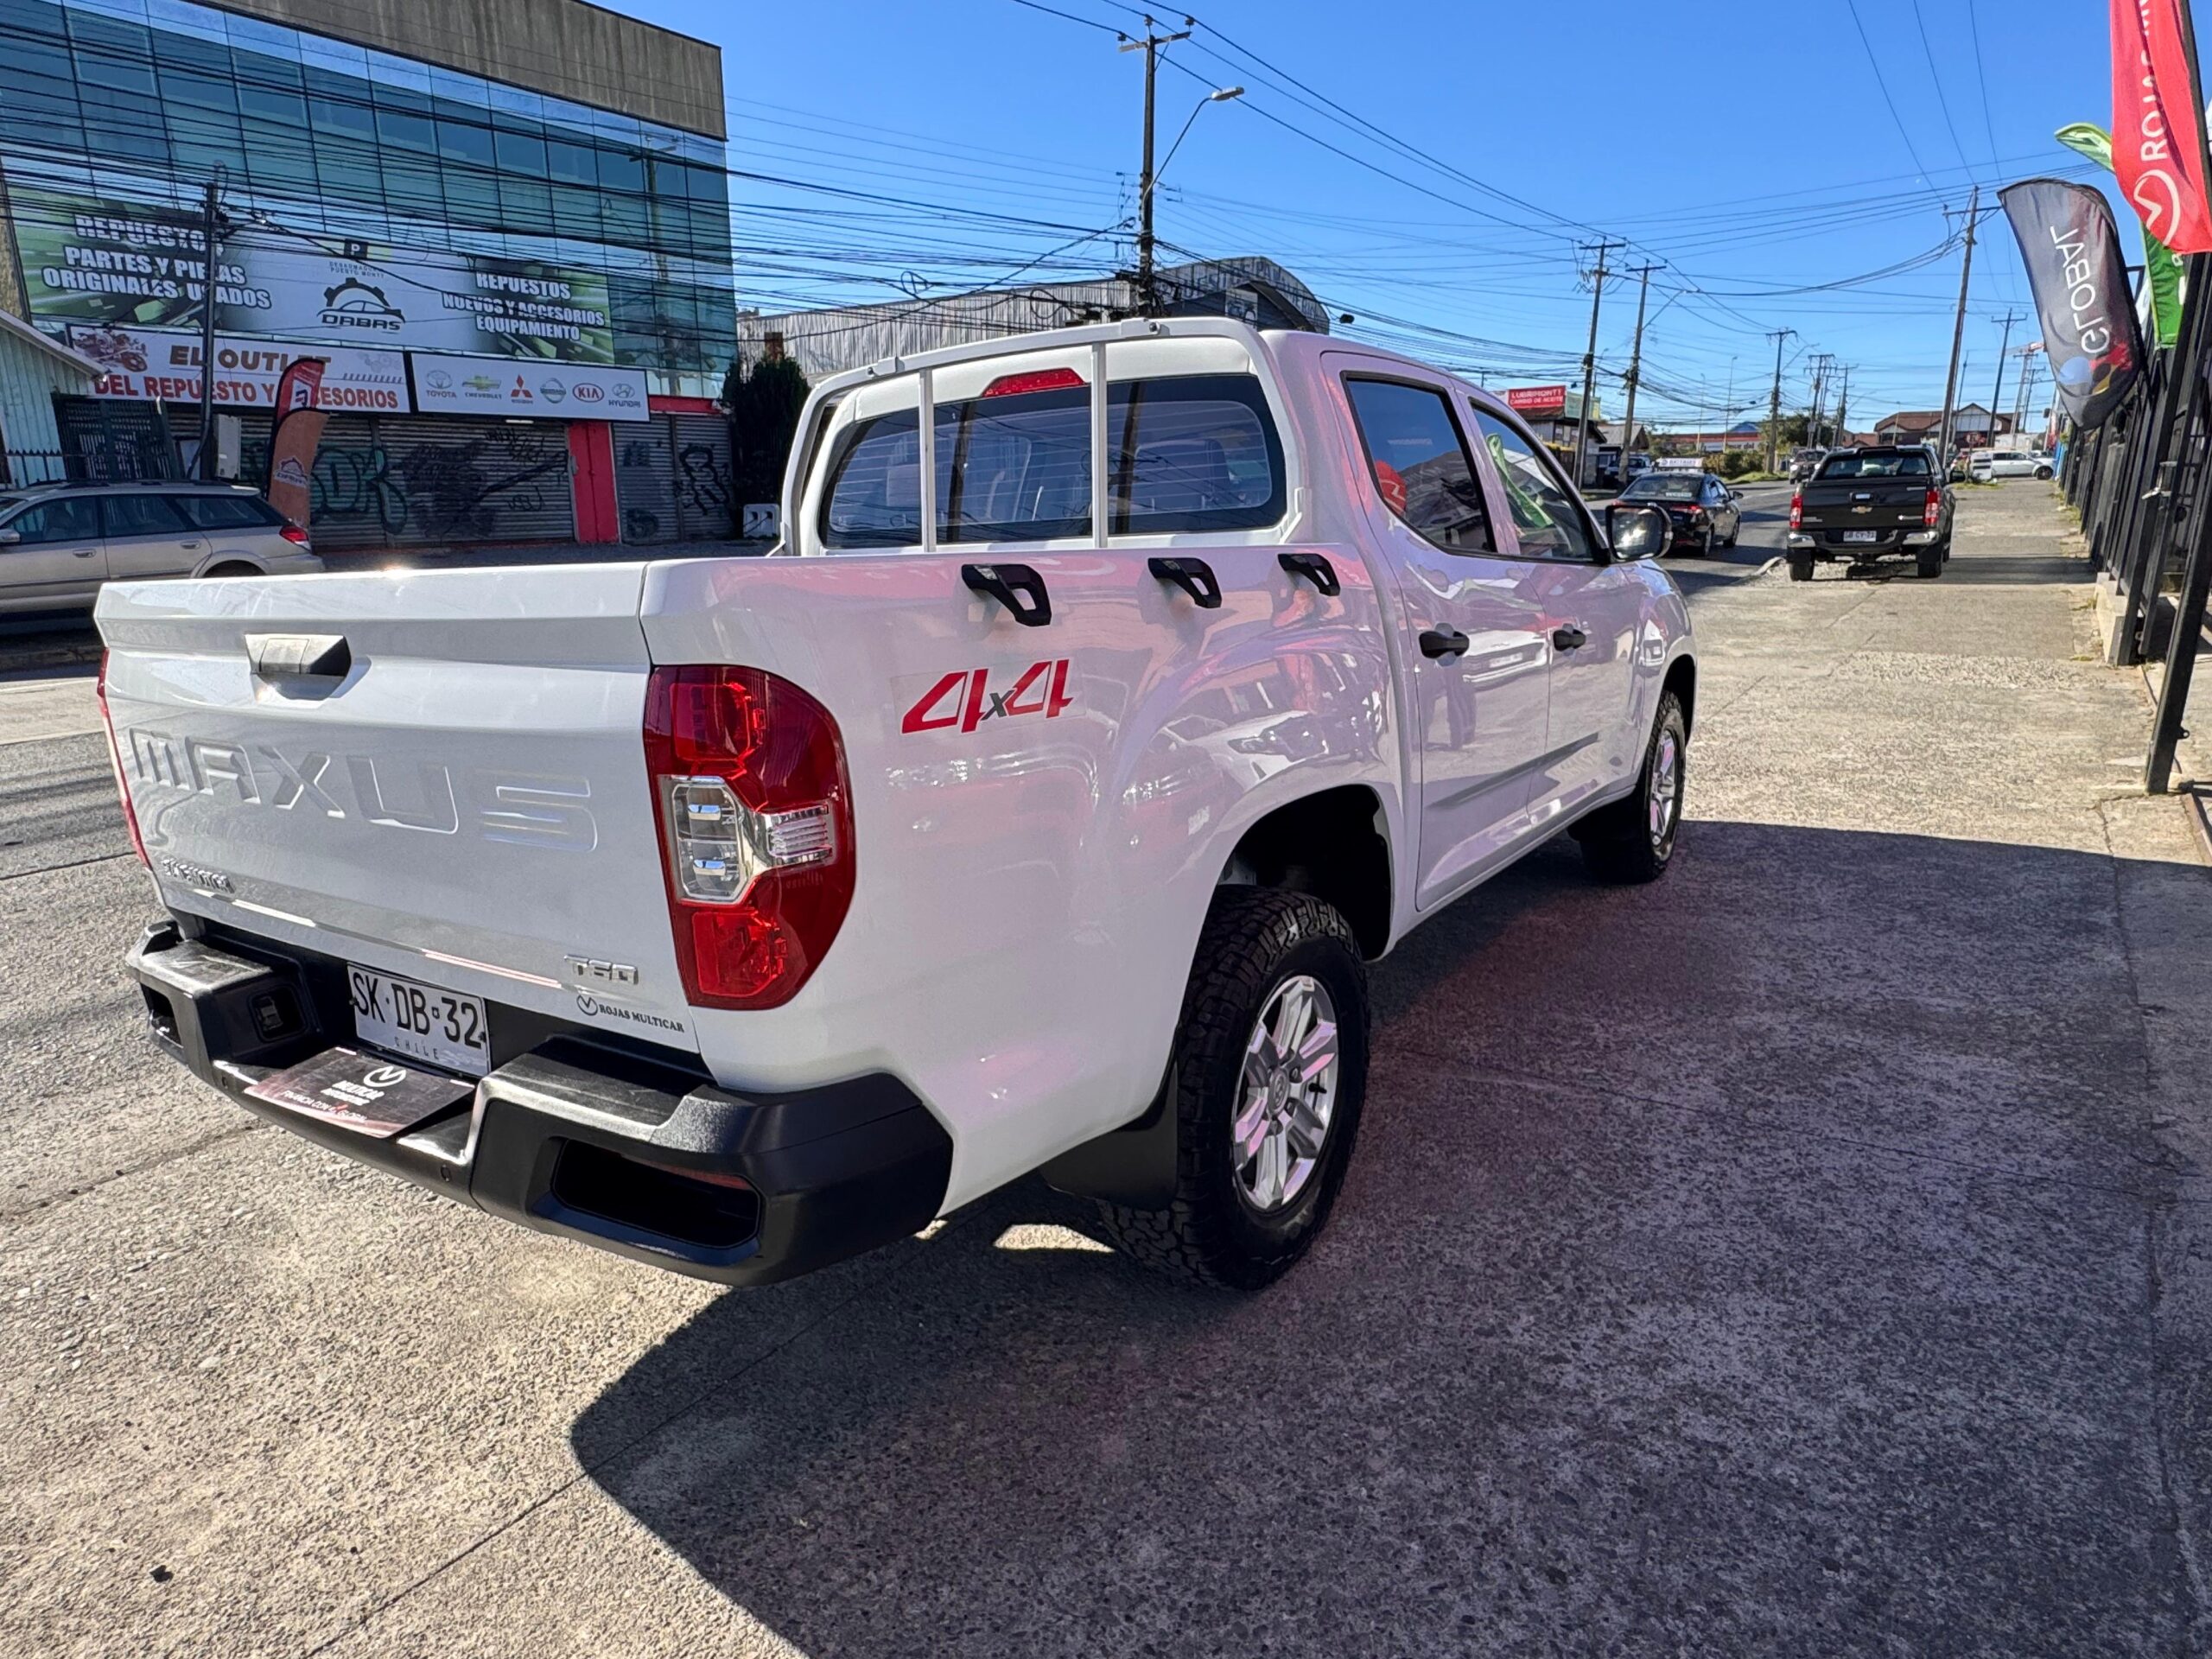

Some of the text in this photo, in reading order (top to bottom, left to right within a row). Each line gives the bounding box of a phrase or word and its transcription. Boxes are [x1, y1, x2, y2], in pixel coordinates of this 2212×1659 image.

[65, 245, 246, 284] PARTES Y PIEAS
[43, 266, 180, 299] ORIGINALES
[476, 273, 571, 299] REPUESTOS
[2050, 226, 2110, 354] GLOBAL
[321, 314, 402, 330] DABAS
[442, 292, 605, 326] NUEVOS Y ACCESORIOS
[476, 315, 581, 340] EQUIPAMIENTO
[169, 345, 332, 375] EL OUTLT
[95, 374, 138, 396] DEL
[143, 376, 257, 402] REPUSTO
[261, 383, 276, 403] Y
[316, 386, 398, 409] ESORIOS
[426, 390, 456, 399] TOYOTA
[578, 386, 599, 399] KIA
[901, 658, 1074, 734] 4x4
[130, 727, 599, 853] MAXUS
[598, 1003, 685, 1033] ROJAS MULTICAR
[394, 1036, 440, 1060] CHILE
